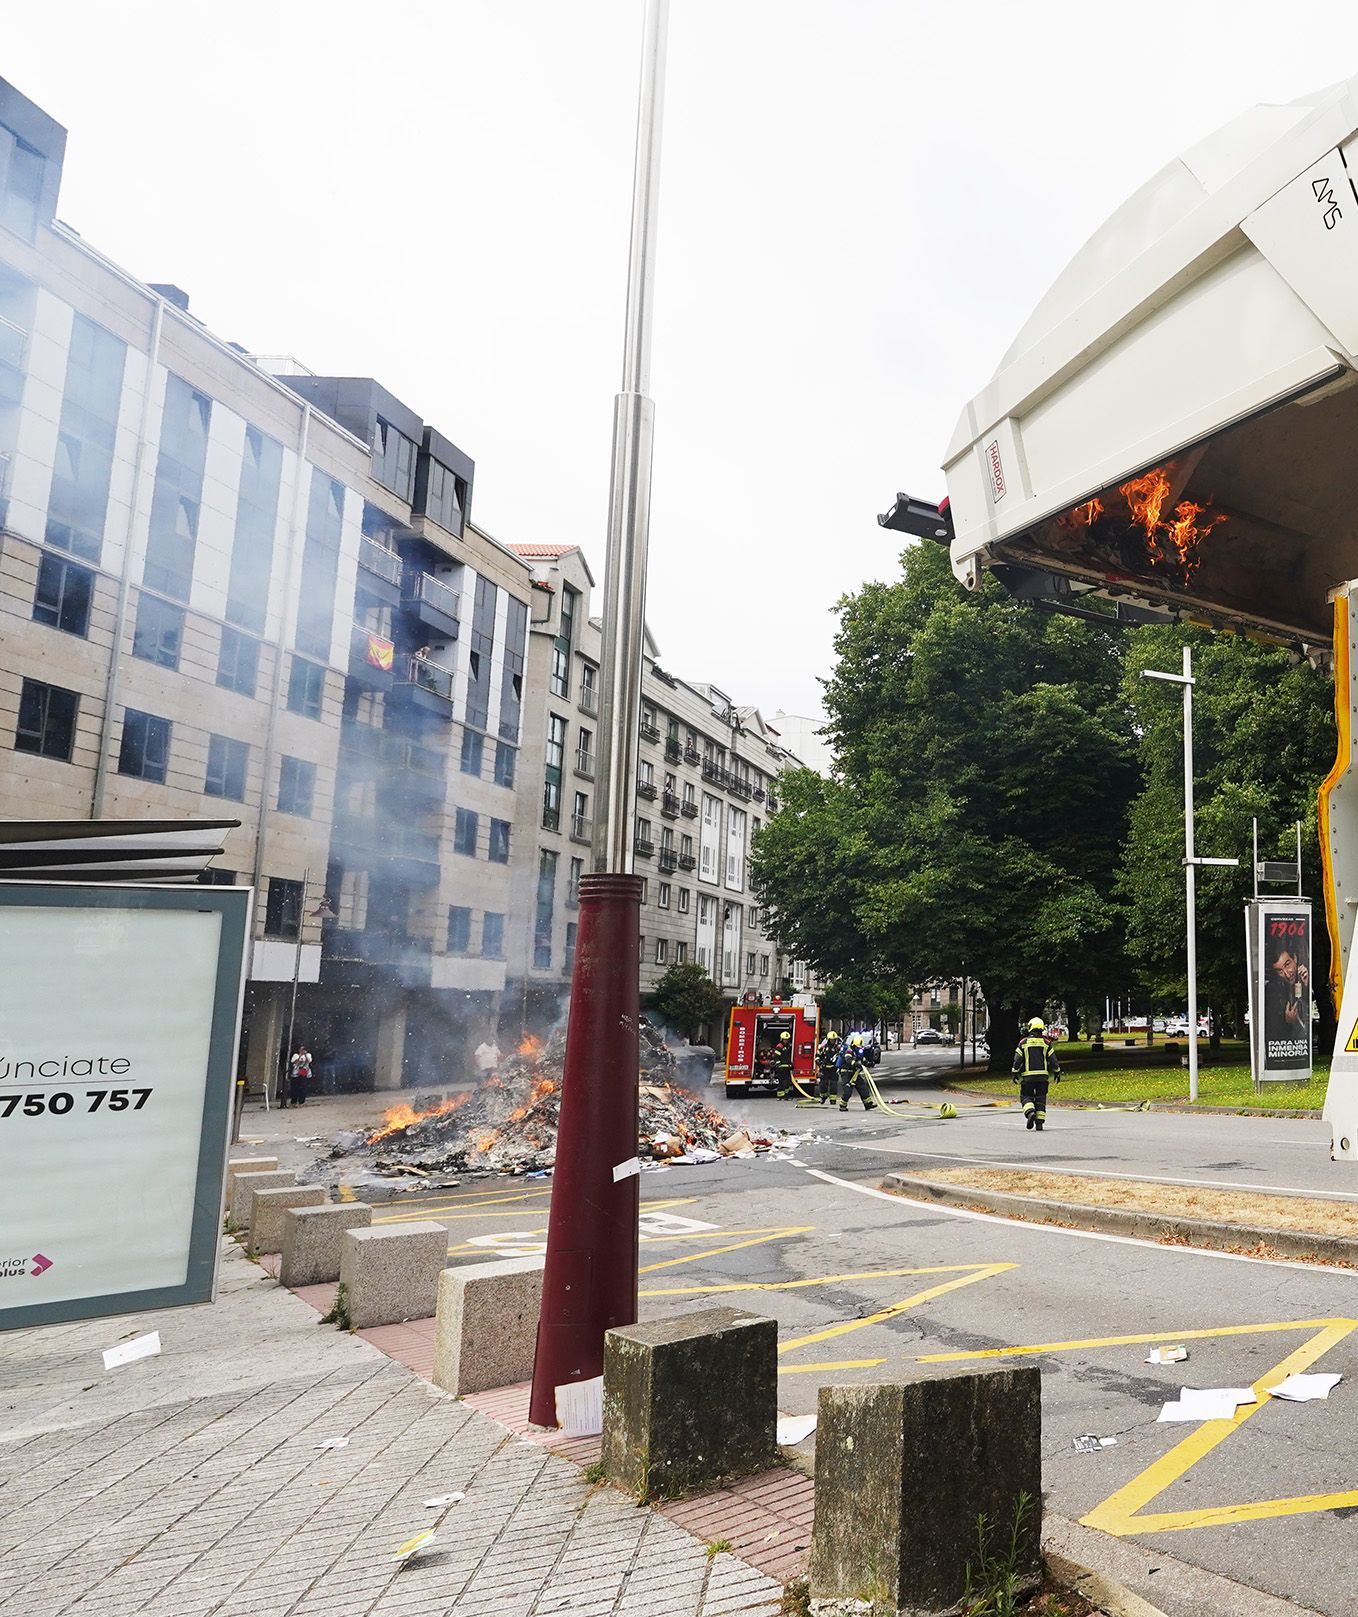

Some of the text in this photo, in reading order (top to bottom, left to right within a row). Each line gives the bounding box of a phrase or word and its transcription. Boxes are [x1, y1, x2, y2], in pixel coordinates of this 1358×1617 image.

[1312, 178, 1343, 230] AMS
[990, 446, 1005, 494] HARDOX
[1270, 921, 1306, 938] 1906
[1268, 1044, 1308, 1052] INMENSA
[86, 1088, 153, 1113] 757
[0, 1258, 28, 1268] rior
